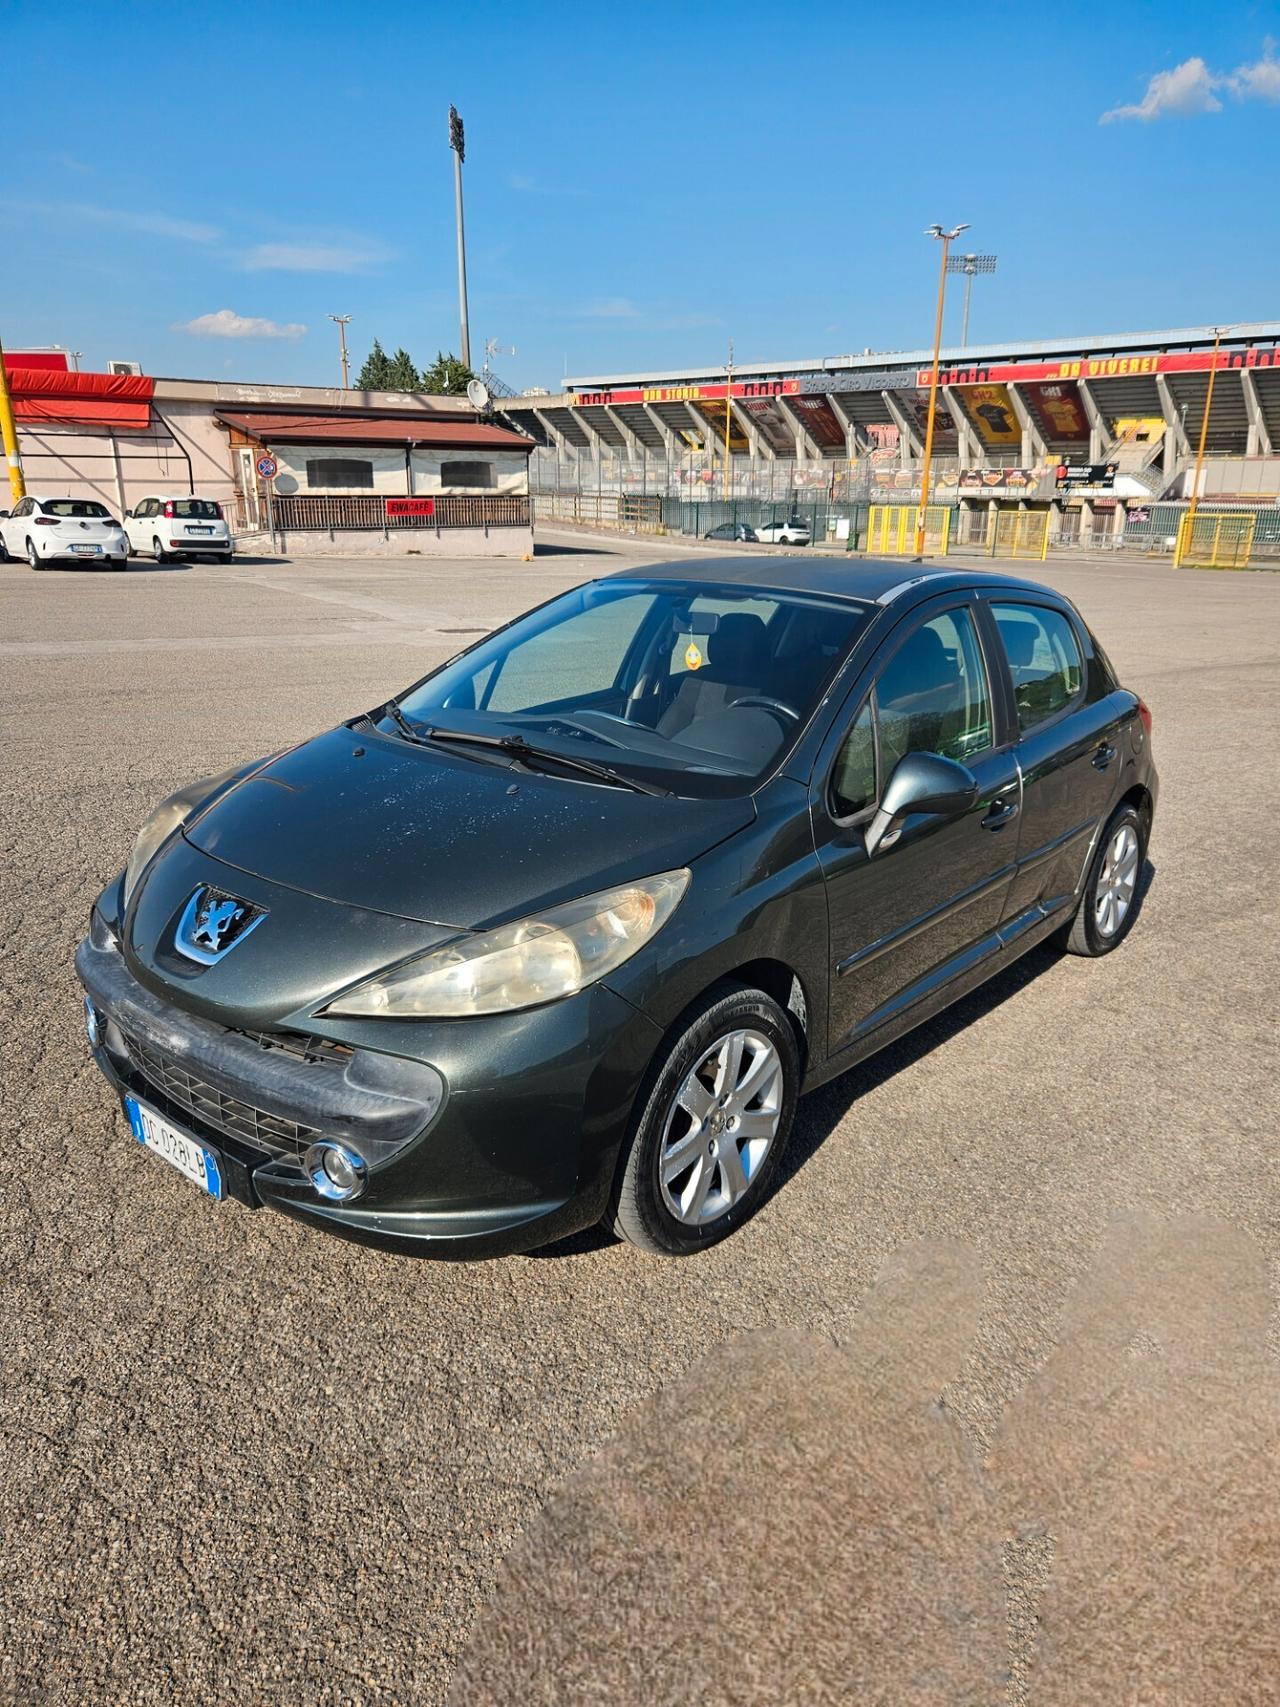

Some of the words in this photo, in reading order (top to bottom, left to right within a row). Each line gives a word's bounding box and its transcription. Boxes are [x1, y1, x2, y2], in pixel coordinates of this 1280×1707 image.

[1089, 357, 1157, 377] VIVERE!
[803, 381, 836, 393] STADIO
[839, 379, 861, 390] CIRO
[864, 377, 910, 390] VIGORITO
